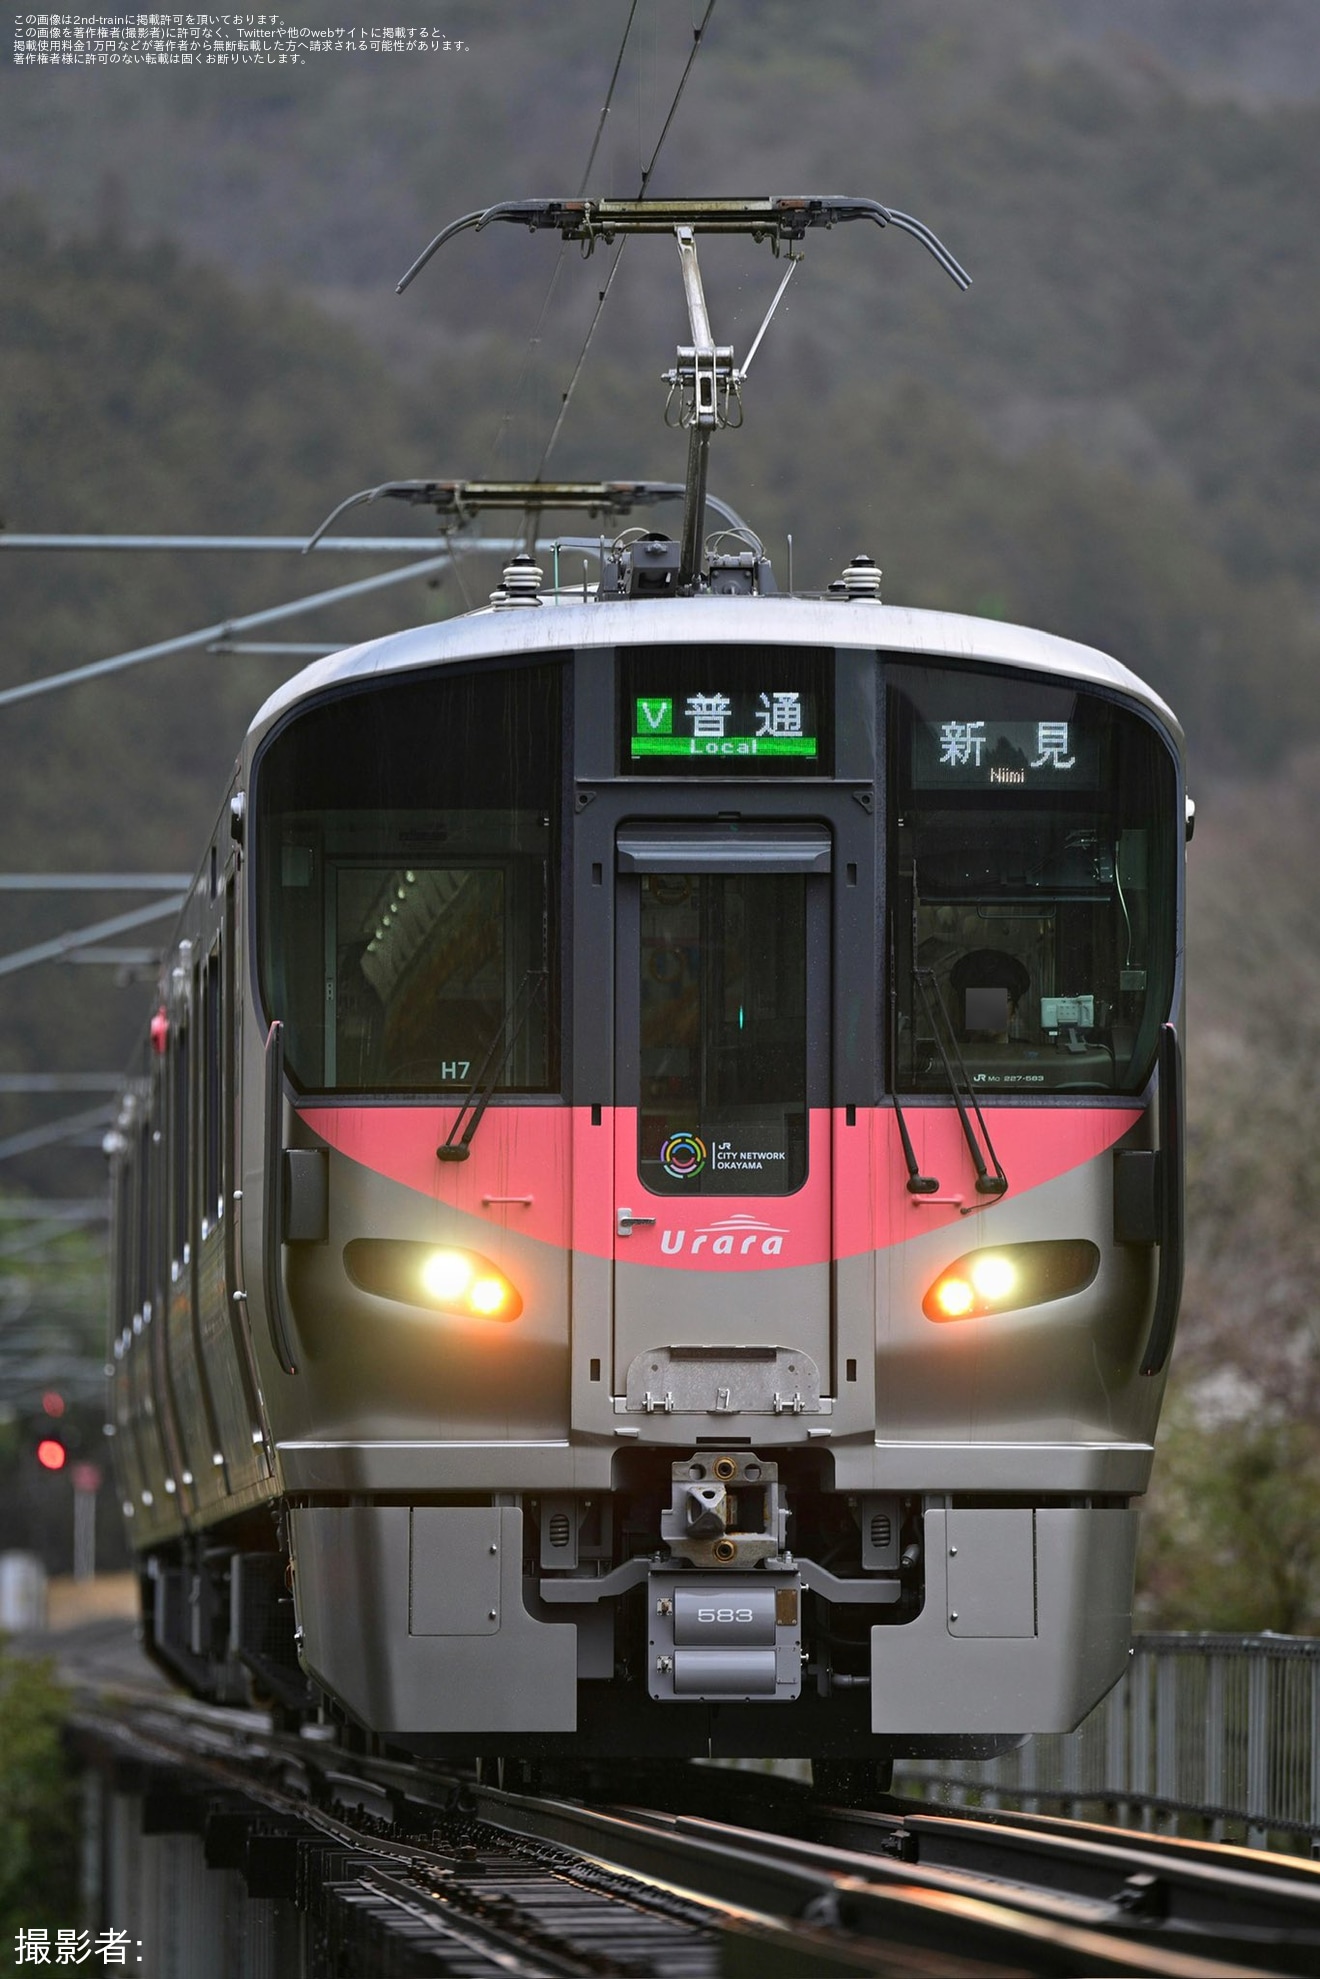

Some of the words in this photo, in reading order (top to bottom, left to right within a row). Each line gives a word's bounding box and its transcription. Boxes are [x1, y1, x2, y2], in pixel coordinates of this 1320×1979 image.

[641, 703, 668, 729] V
[684, 692, 803, 737] 普通
[689, 738, 758, 755] Local
[939, 721, 1076, 769] 新見
[990, 767, 1025, 784] Niimi
[441, 1061, 470, 1079] H7
[973, 1073, 986, 1082] JR
[718, 1142, 731, 1150] JR
[717, 1152, 737, 1160] CITY
[740, 1152, 786, 1160] NETWORK
[717, 1162, 763, 1170] OKAYAMA
[660, 1230, 783, 1255] Urara
[698, 1608, 753, 1623] 583
